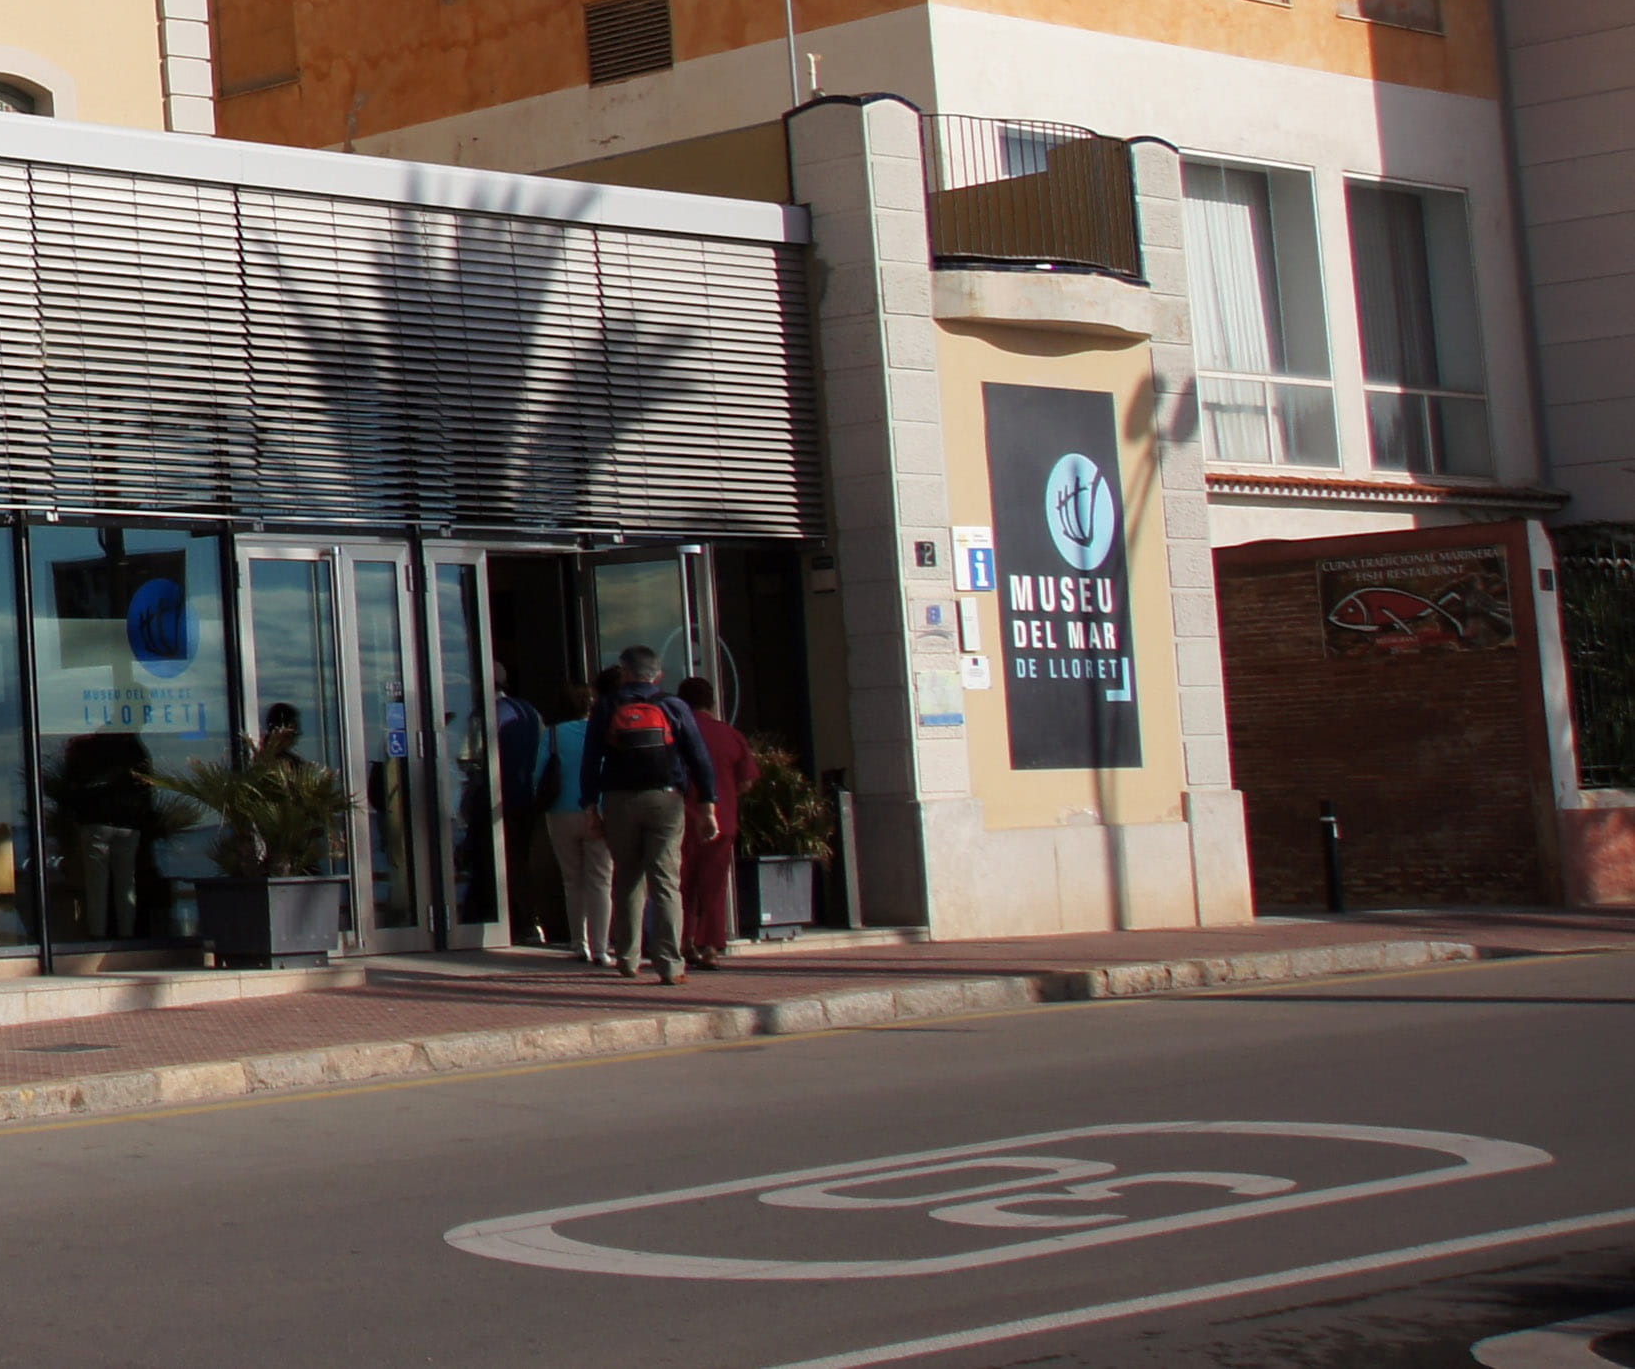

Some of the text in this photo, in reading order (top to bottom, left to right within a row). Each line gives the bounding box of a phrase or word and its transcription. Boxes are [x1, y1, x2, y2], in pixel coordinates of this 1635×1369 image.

[1322, 547, 1499, 573] CUINA TRADICIONAL MARINERA
[1355, 564, 1466, 582] FISH RESTAURANT
[1009, 574, 1113, 613] MUSEU
[1013, 620, 1117, 650] DEL MAR
[1015, 658, 1118, 679] DE LLORET
[82, 689, 121, 700] MUSEU
[125, 689, 145, 700] DEL
[84, 704, 191, 725] LLORET
